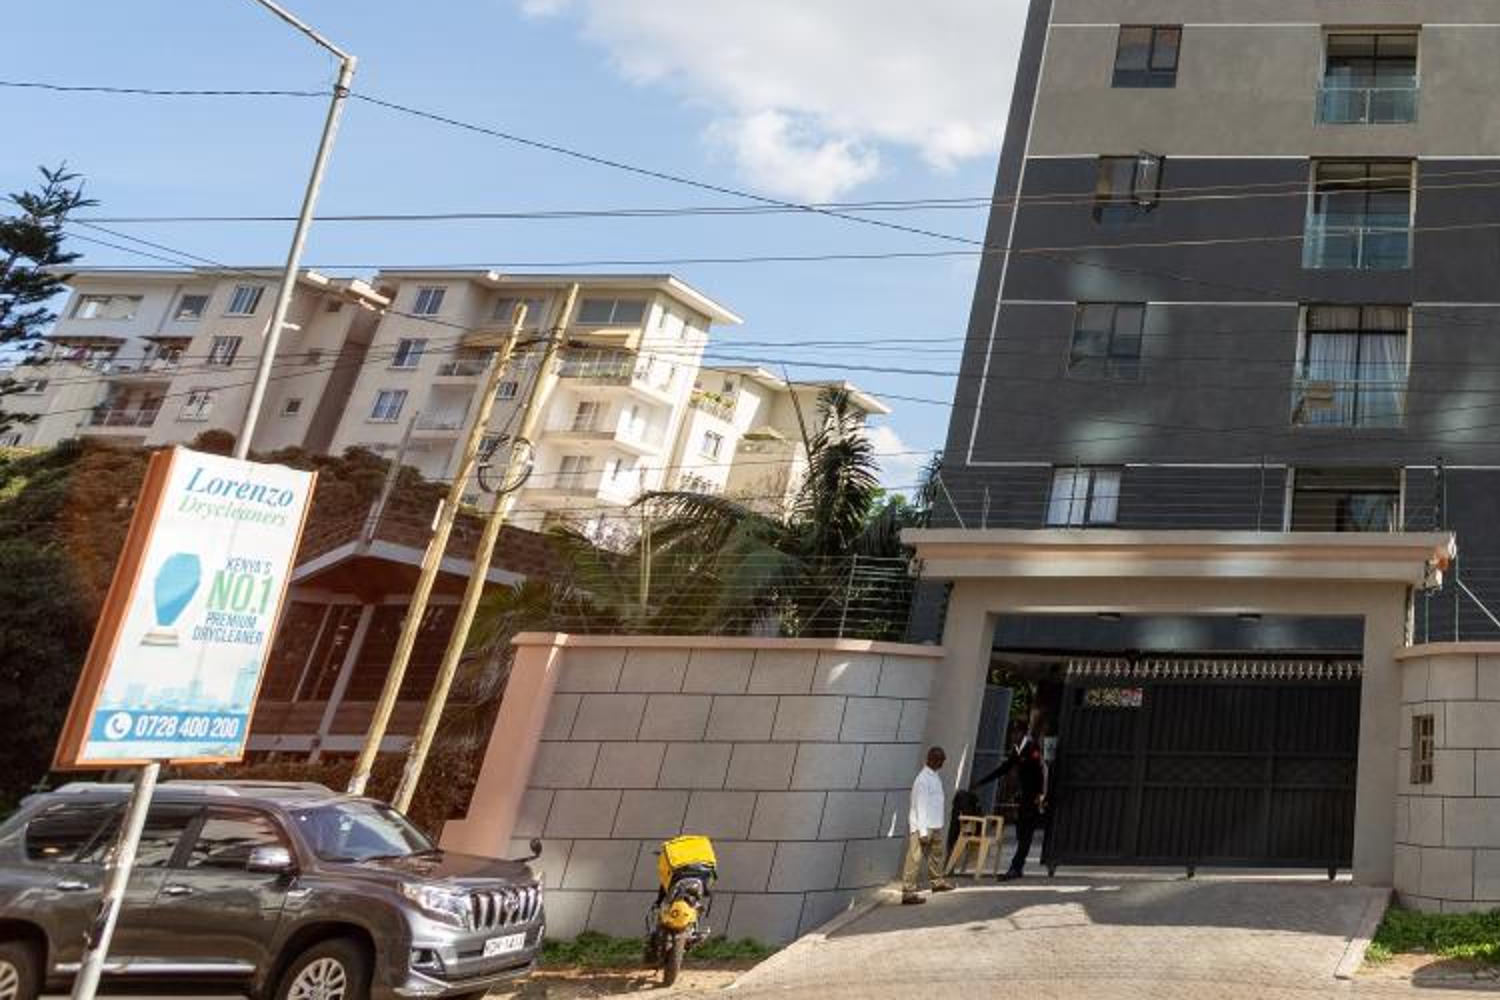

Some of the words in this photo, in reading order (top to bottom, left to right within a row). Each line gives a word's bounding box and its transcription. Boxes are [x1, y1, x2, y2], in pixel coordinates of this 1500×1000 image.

[185, 467, 294, 507] Lorenzo
[179, 494, 287, 526] Drycleaners
[226, 557, 272, 575] KENYA'S
[206, 570, 274, 614] NO.1
[205, 611, 257, 629] PREMIUM
[134, 714, 178, 737] 0728
[178, 716, 209, 738] 400
[209, 717, 240, 739] 200
